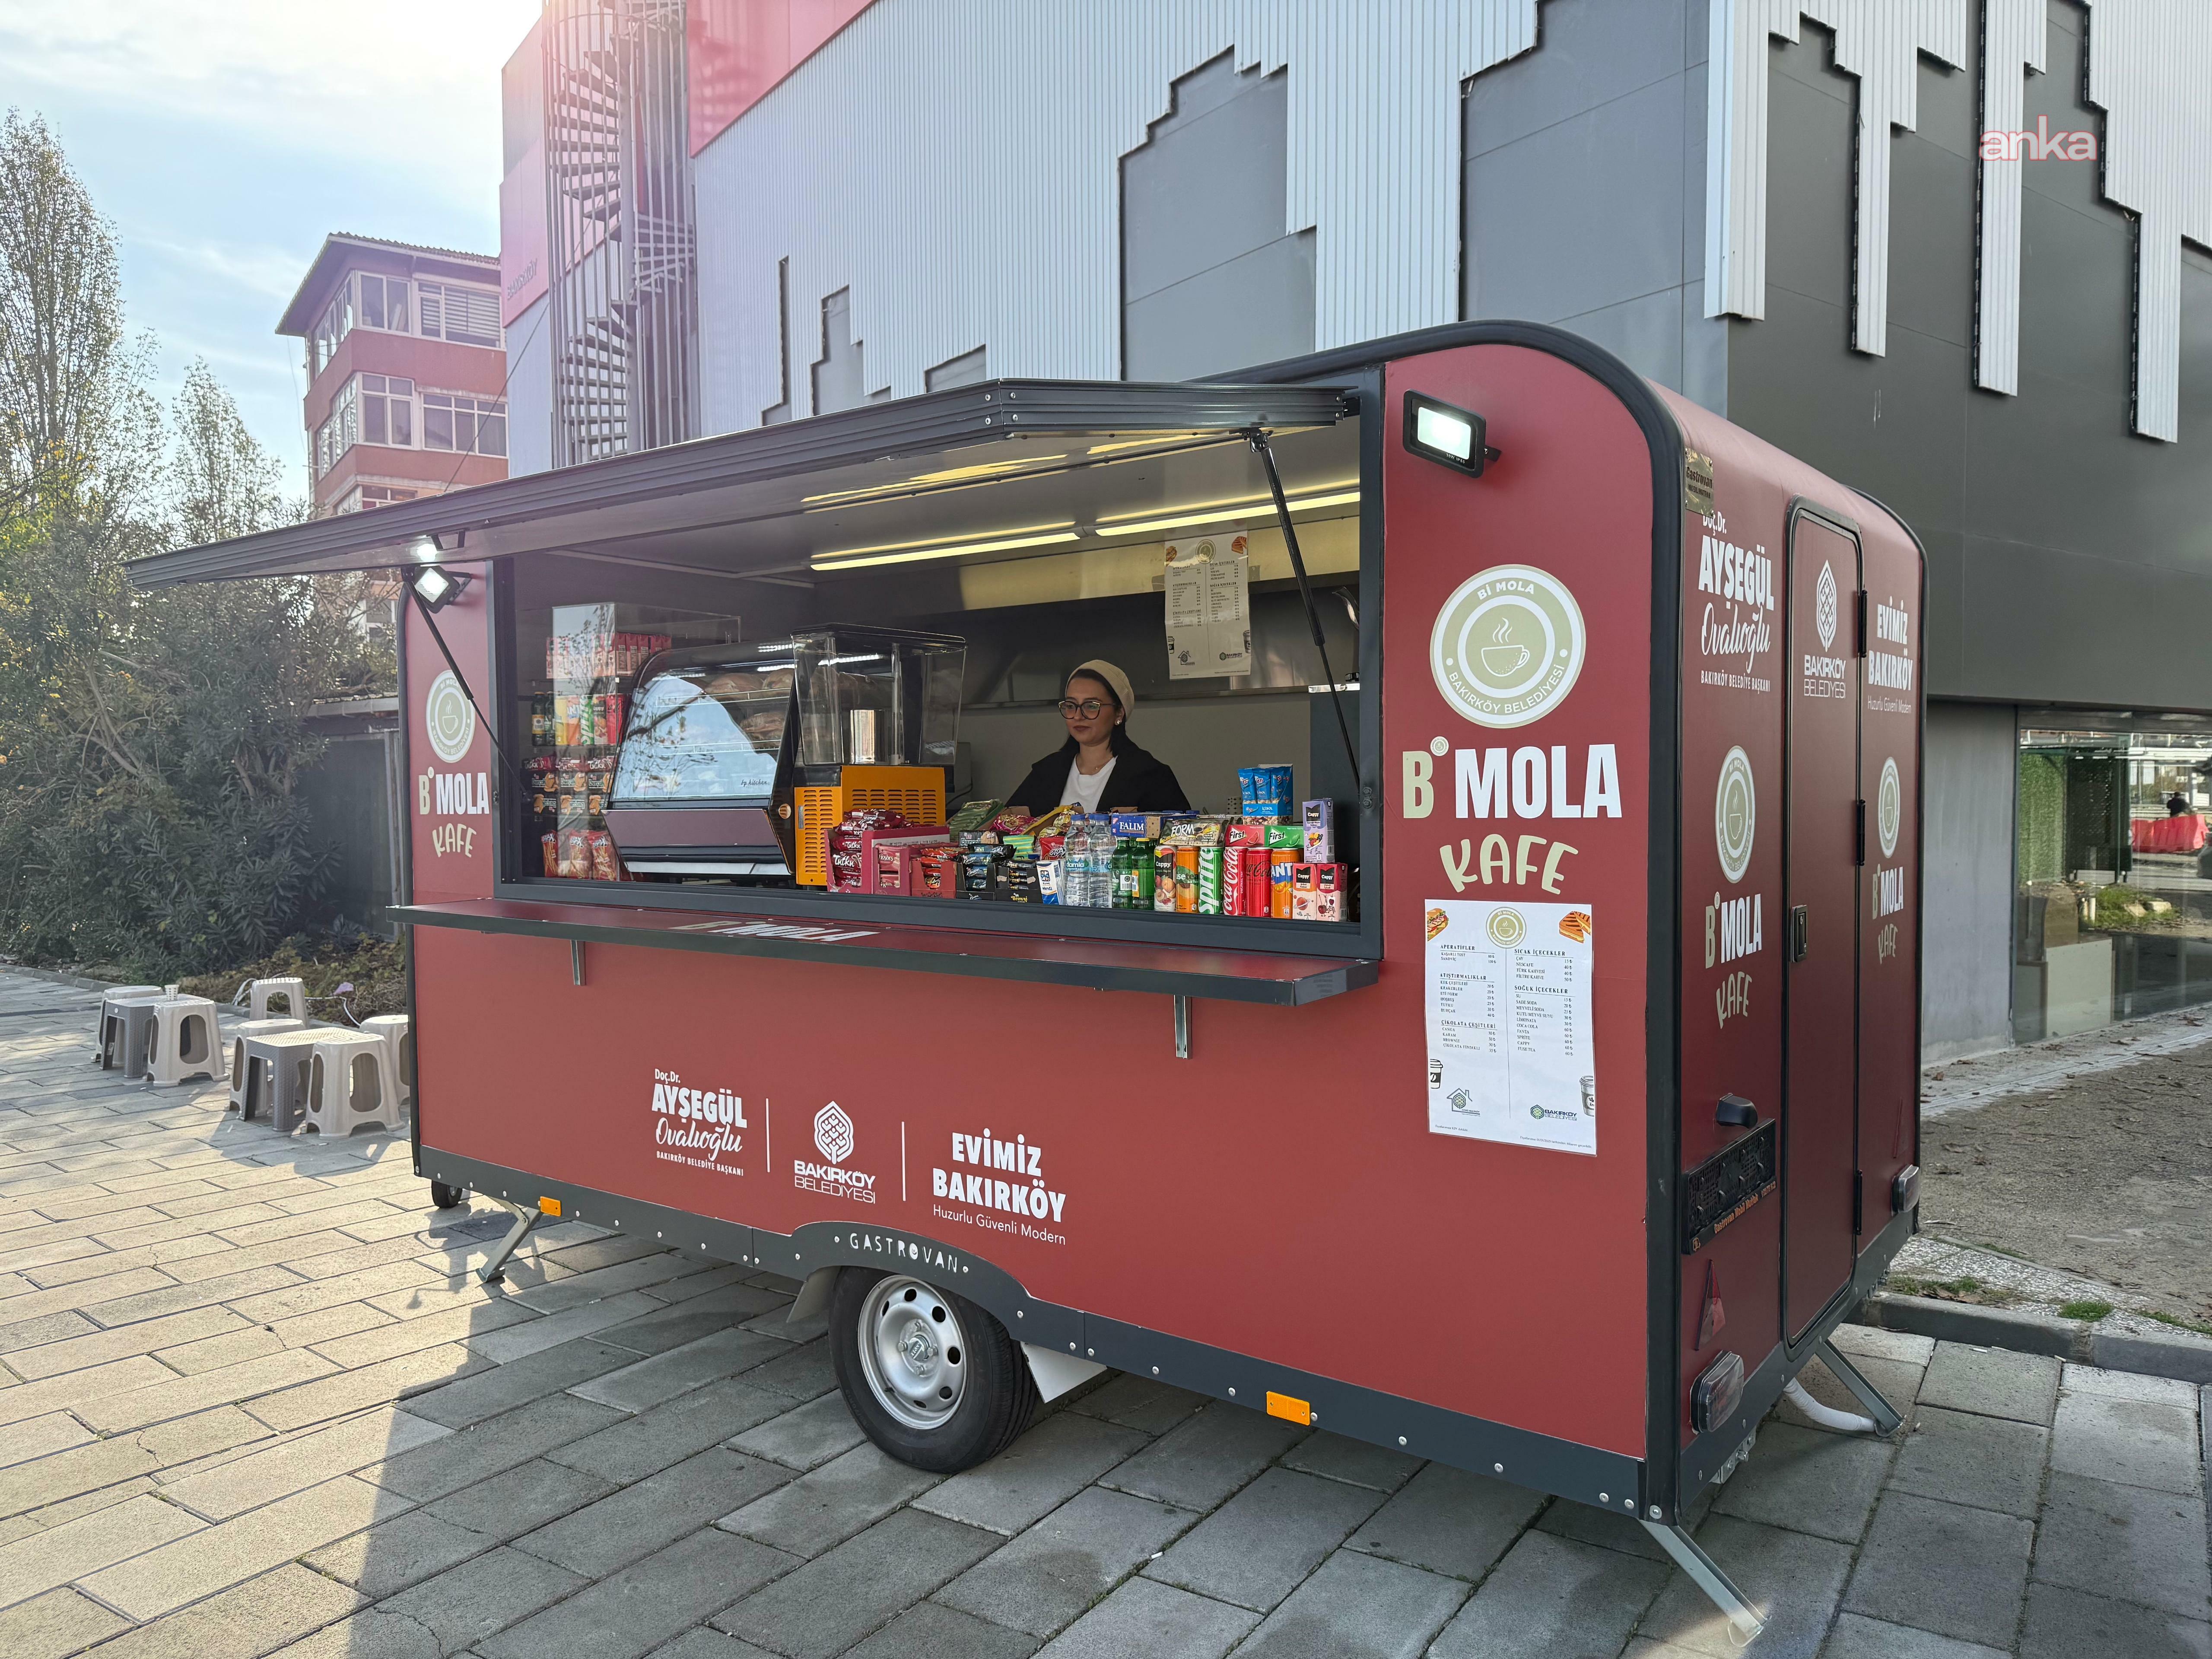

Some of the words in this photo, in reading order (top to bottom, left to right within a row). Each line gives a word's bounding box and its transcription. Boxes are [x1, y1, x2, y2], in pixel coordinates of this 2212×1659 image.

[1686, 467, 1713, 489] Gastrovan
[1496, 581, 1534, 594] MOLA
[1698, 535, 1774, 610] AYŞEGÜL
[1701, 603, 1770, 673] Ovalıoğlu
[1877, 596, 1908, 645] EVİMİZ
[1701, 670, 1728, 686] BAKIRKÖY
[1729, 673, 1750, 689] BELEDİYE
[1752, 678, 1770, 694] BAŞKANI
[1804, 655, 1846, 679] BAKIRKÖY
[1869, 648, 1913, 690] BAKIRKÖY
[1449, 671, 1501, 714] BAKIRKÖY
[1505, 664, 1565, 714] BELEDİYESİ
[436, 772, 489, 815] MOLA
[1455, 744, 1622, 818] MOLA
[432, 823, 477, 858] KAFE
[1119, 822, 1144, 831] FALIM
[1171, 823, 1194, 837] FORM
[1230, 830, 1246, 839] First
[1269, 831, 1285, 842] First
[833, 854, 855, 867] Tutku
[1271, 862, 1293, 877] ANT
[1440, 834, 1578, 894] KAFE
[1880, 866, 1903, 917] MOLA
[1721, 893, 1762, 963] MOLA
[1878, 923, 1897, 964] KAFE
[1716, 971, 1752, 1030] KAFE
[655, 1068, 680, 1084] Doç.Dr.
[652, 1083, 747, 1128] AYŞEGÜL
[656, 1117, 743, 1161] Ovalıoğlu
[952, 1128, 1041, 1177] EVİMİZ
[656, 1151, 686, 1163] BAKIRKÖY
[687, 1157, 715, 1170] BELEDİYE
[717, 1163, 744, 1176] BAŞKANI
[794, 1160, 876, 1189] BAKIRKÖY
[933, 1168, 1066, 1223] BAKIRKÖY
[934, 1204, 972, 1224] Huzurlu
[976, 1214, 1017, 1234] Güvenli
[1021, 1224, 1065, 1245] Modern
[850, 1232, 957, 1273] GASTROVAN
